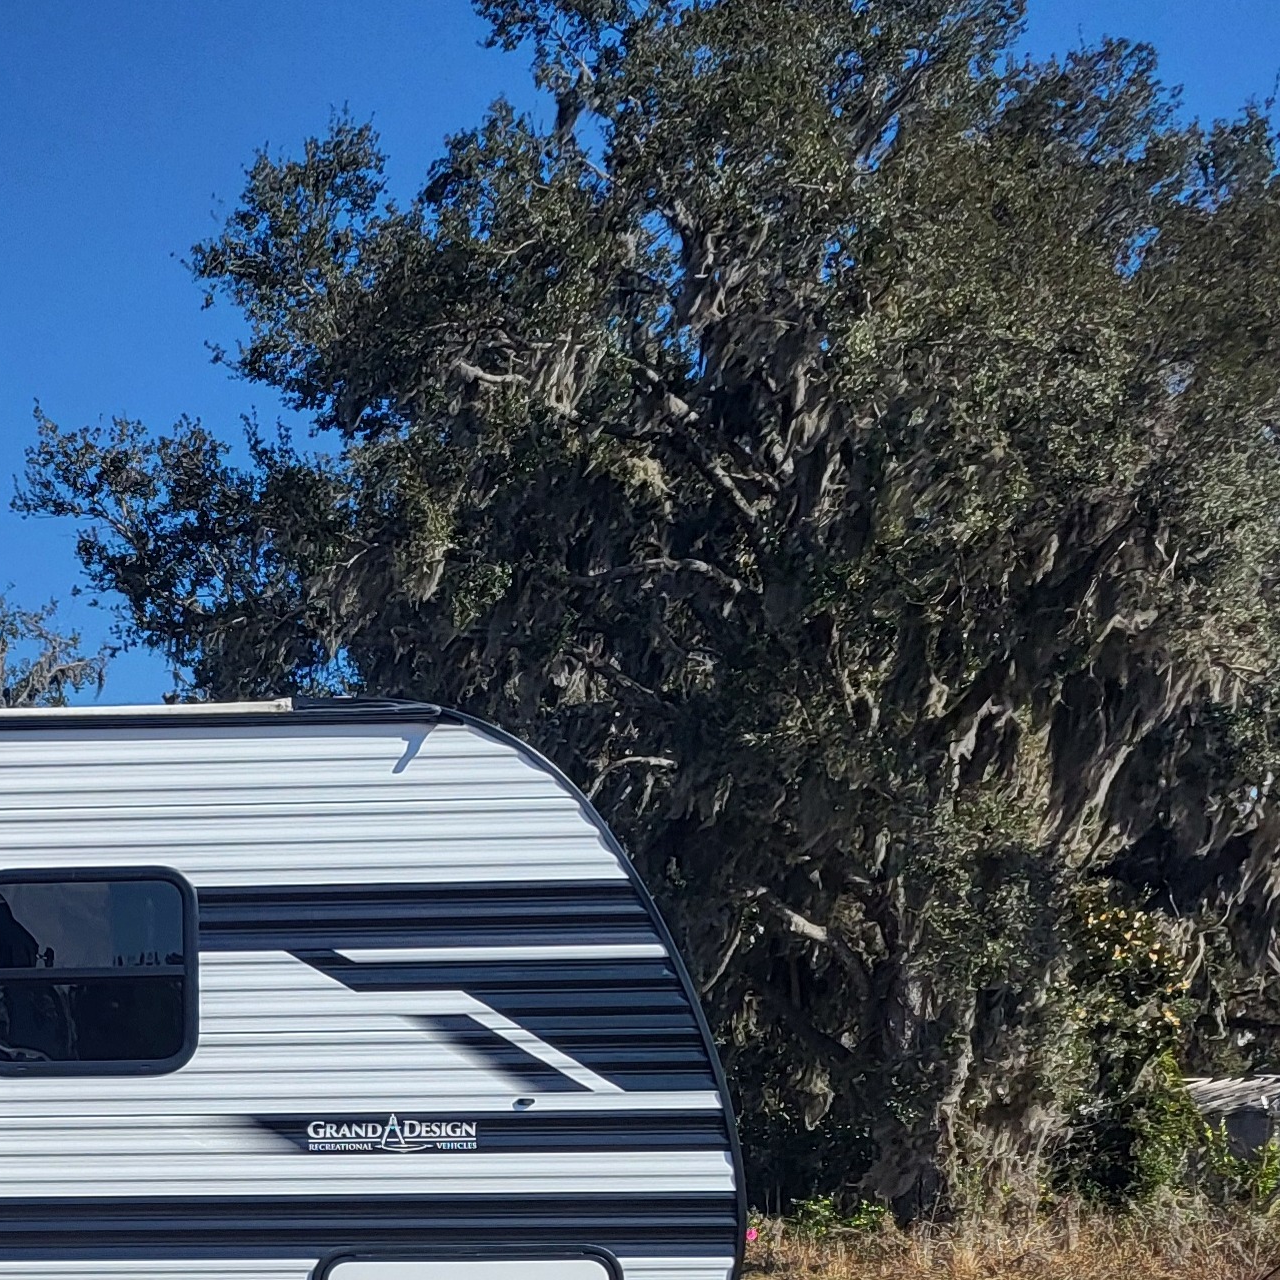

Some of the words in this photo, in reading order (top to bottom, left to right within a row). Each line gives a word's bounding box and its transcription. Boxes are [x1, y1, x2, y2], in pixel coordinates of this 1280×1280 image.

[307, 1121, 382, 1138] GRAND
[403, 1120, 477, 1138] DESIGN
[309, 1143, 373, 1151] RECREATIONAL
[436, 1142, 477, 1150] VEHICLES
